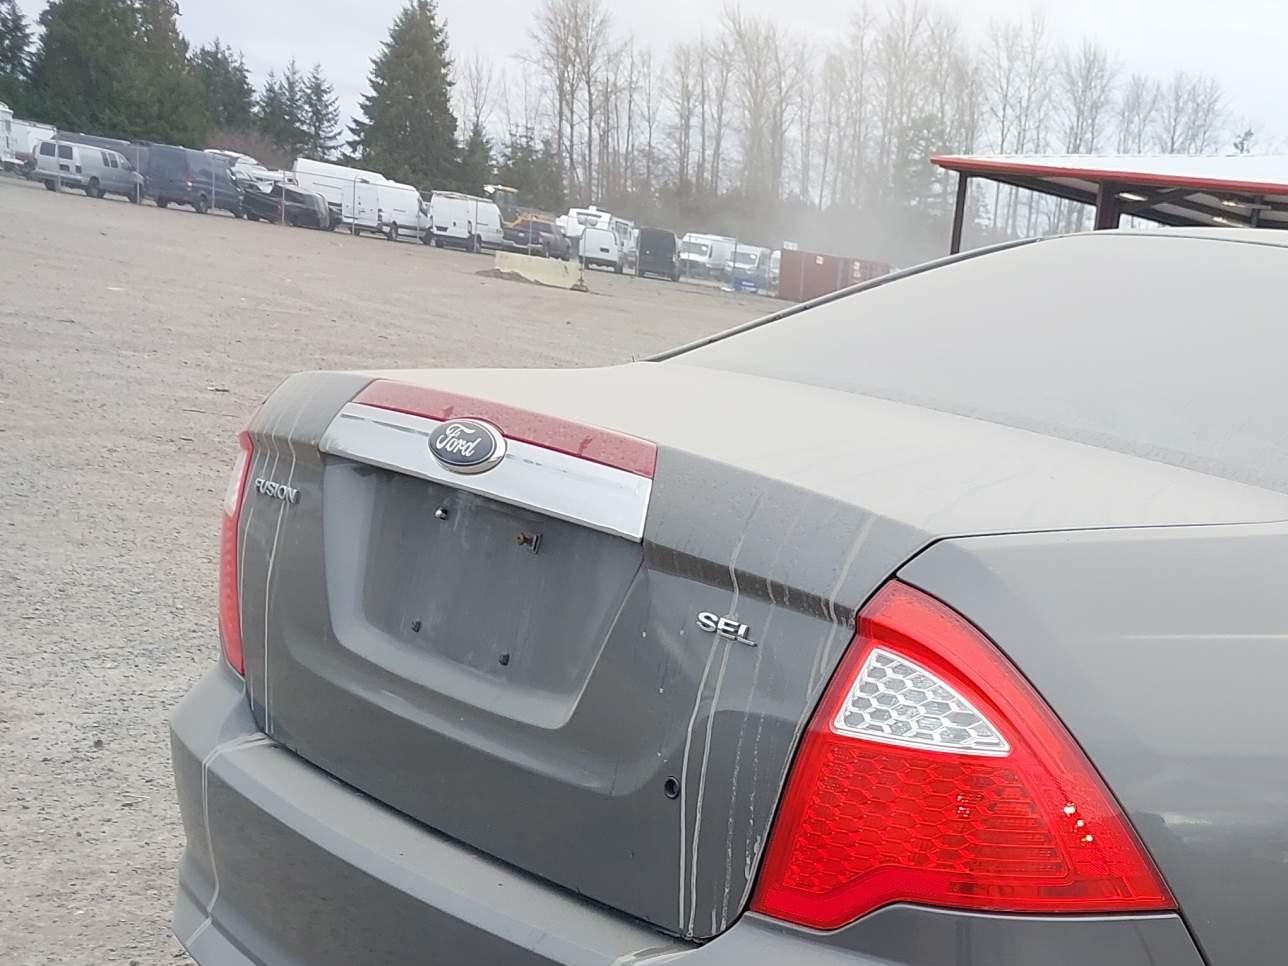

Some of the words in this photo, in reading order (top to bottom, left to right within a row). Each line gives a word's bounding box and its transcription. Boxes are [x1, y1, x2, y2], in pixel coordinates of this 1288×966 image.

[435, 423, 482, 457] Ford
[255, 478, 299, 504] FUSION
[696, 611, 757, 648] SEL
